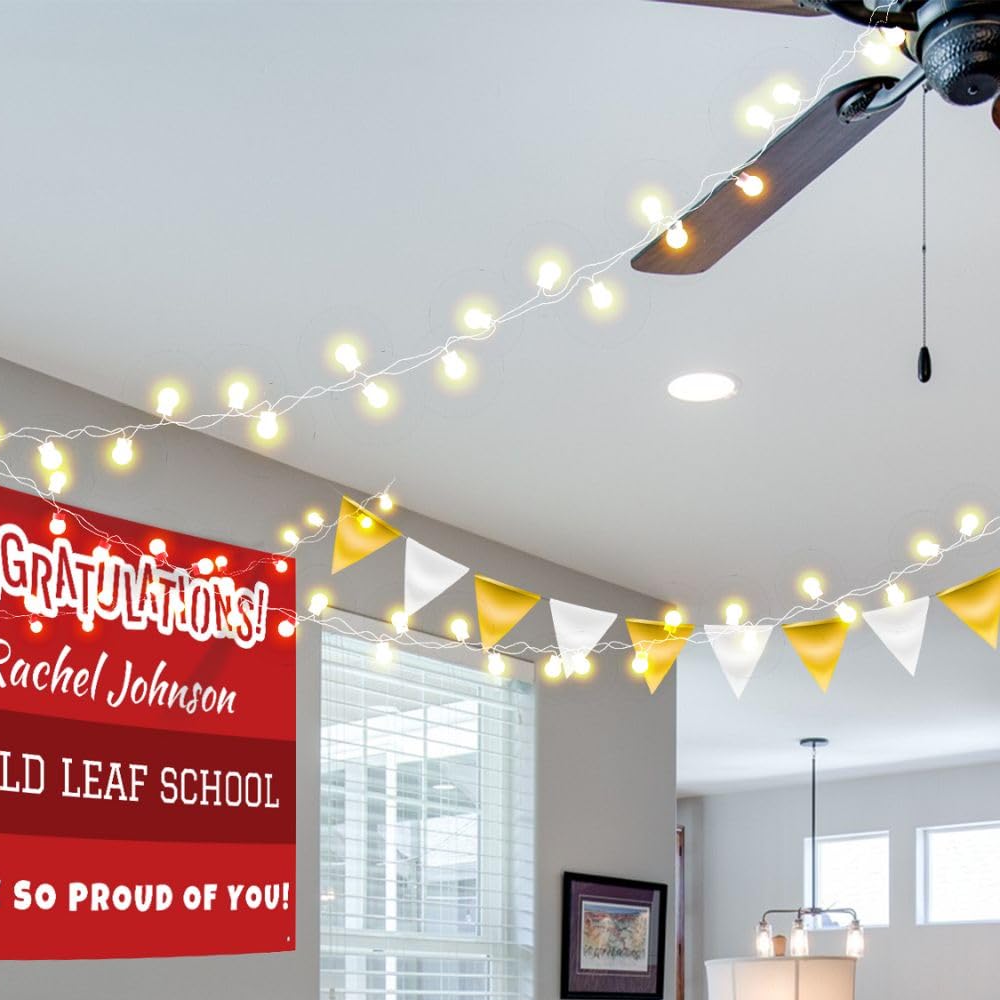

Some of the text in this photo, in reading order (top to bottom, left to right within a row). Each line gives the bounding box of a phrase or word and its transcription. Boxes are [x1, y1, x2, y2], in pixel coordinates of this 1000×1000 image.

[107, 659, 238, 715] Johnson
[61, 757, 148, 803] LEAF
[160, 766, 280, 808] SCHOOL
[13, 879, 57, 911] SO
[68, 882, 173, 912] PROUD
[183, 883, 218, 911] OF
[227, 882, 290, 911] YOU!
